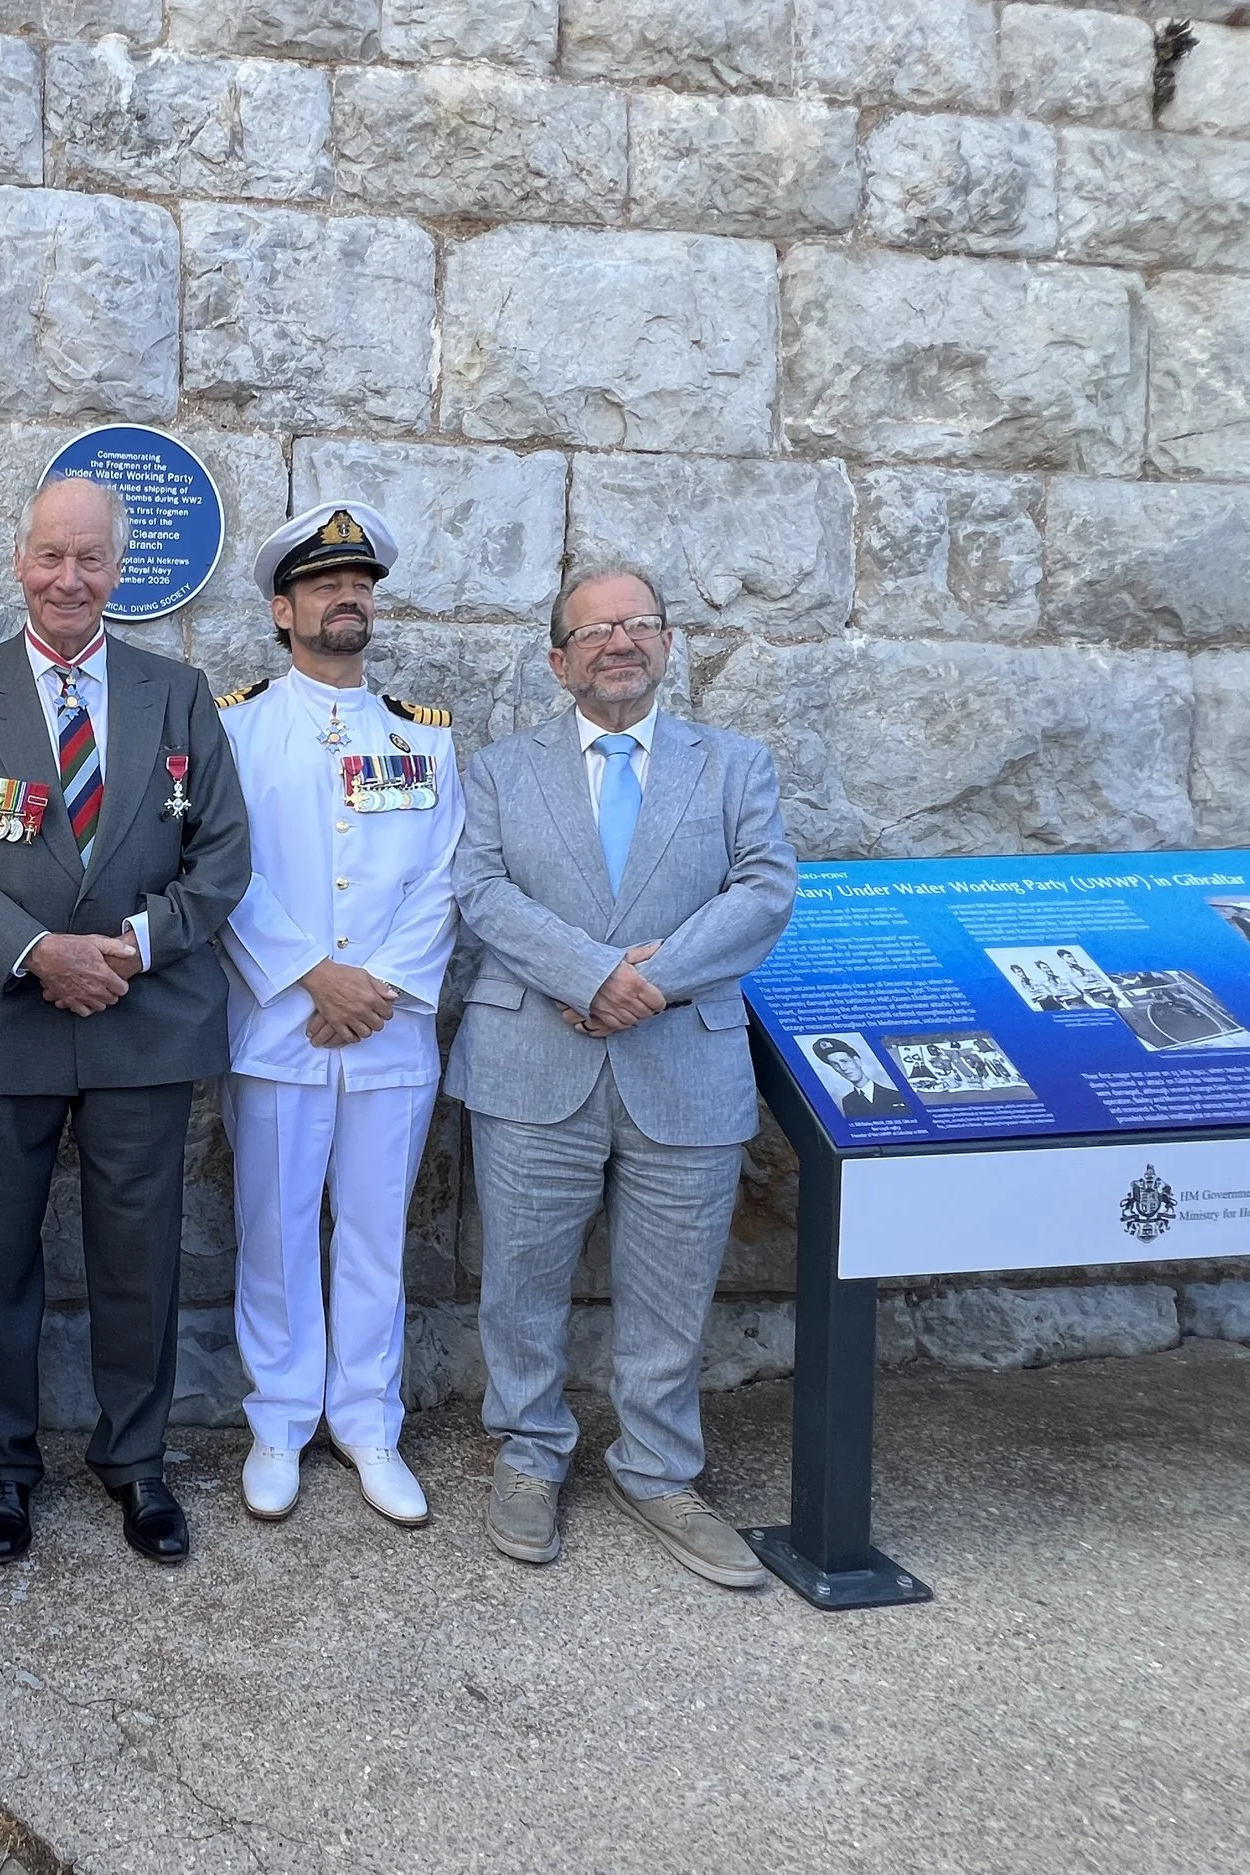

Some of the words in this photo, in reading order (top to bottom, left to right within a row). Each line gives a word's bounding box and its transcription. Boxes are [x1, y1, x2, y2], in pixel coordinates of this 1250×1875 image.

[97, 450, 161, 463] Commemorating
[90, 460, 104, 468] the
[106, 460, 141, 471] Frogmen
[154, 463, 167, 471] the
[65, 467, 93, 478] Under
[95, 469, 123, 479] Water
[126, 471, 165, 483] Working
[168, 473, 194, 484] Party
[119, 484, 141, 492] Allied
[144, 485, 177, 495] shipping
[180, 486, 189, 494] of
[126, 494, 152, 503] bombs
[155, 496, 179, 505] during
[181, 496, 203, 505] WW2
[137, 507, 154, 515] first
[156, 507, 189, 517] frogmen
[159, 518, 173, 526] the
[132, 529, 180, 540] Clearance
[130, 540, 163, 550] Branch
[156, 557, 190, 565] Nekrews
[129, 566, 150, 575] Royal
[152, 566, 172, 576] Navy
[130, 602, 159, 613] DIVING
[160, 583, 191, 607] SOCIETY
[836, 884, 890, 897] Under
[892, 883, 946, 896] Water
[948, 880, 1026, 895] Working
[1022, 878, 1069, 893] Party
[1070, 873, 1151, 892] (UWWP)
[1150, 875, 1172, 887] in
[1172, 873, 1246, 887] Gibraltar
[1180, 1190, 1199, 1202] HM
[1179, 1210, 1219, 1222] Ministry
[1222, 1208, 1237, 1219] for
